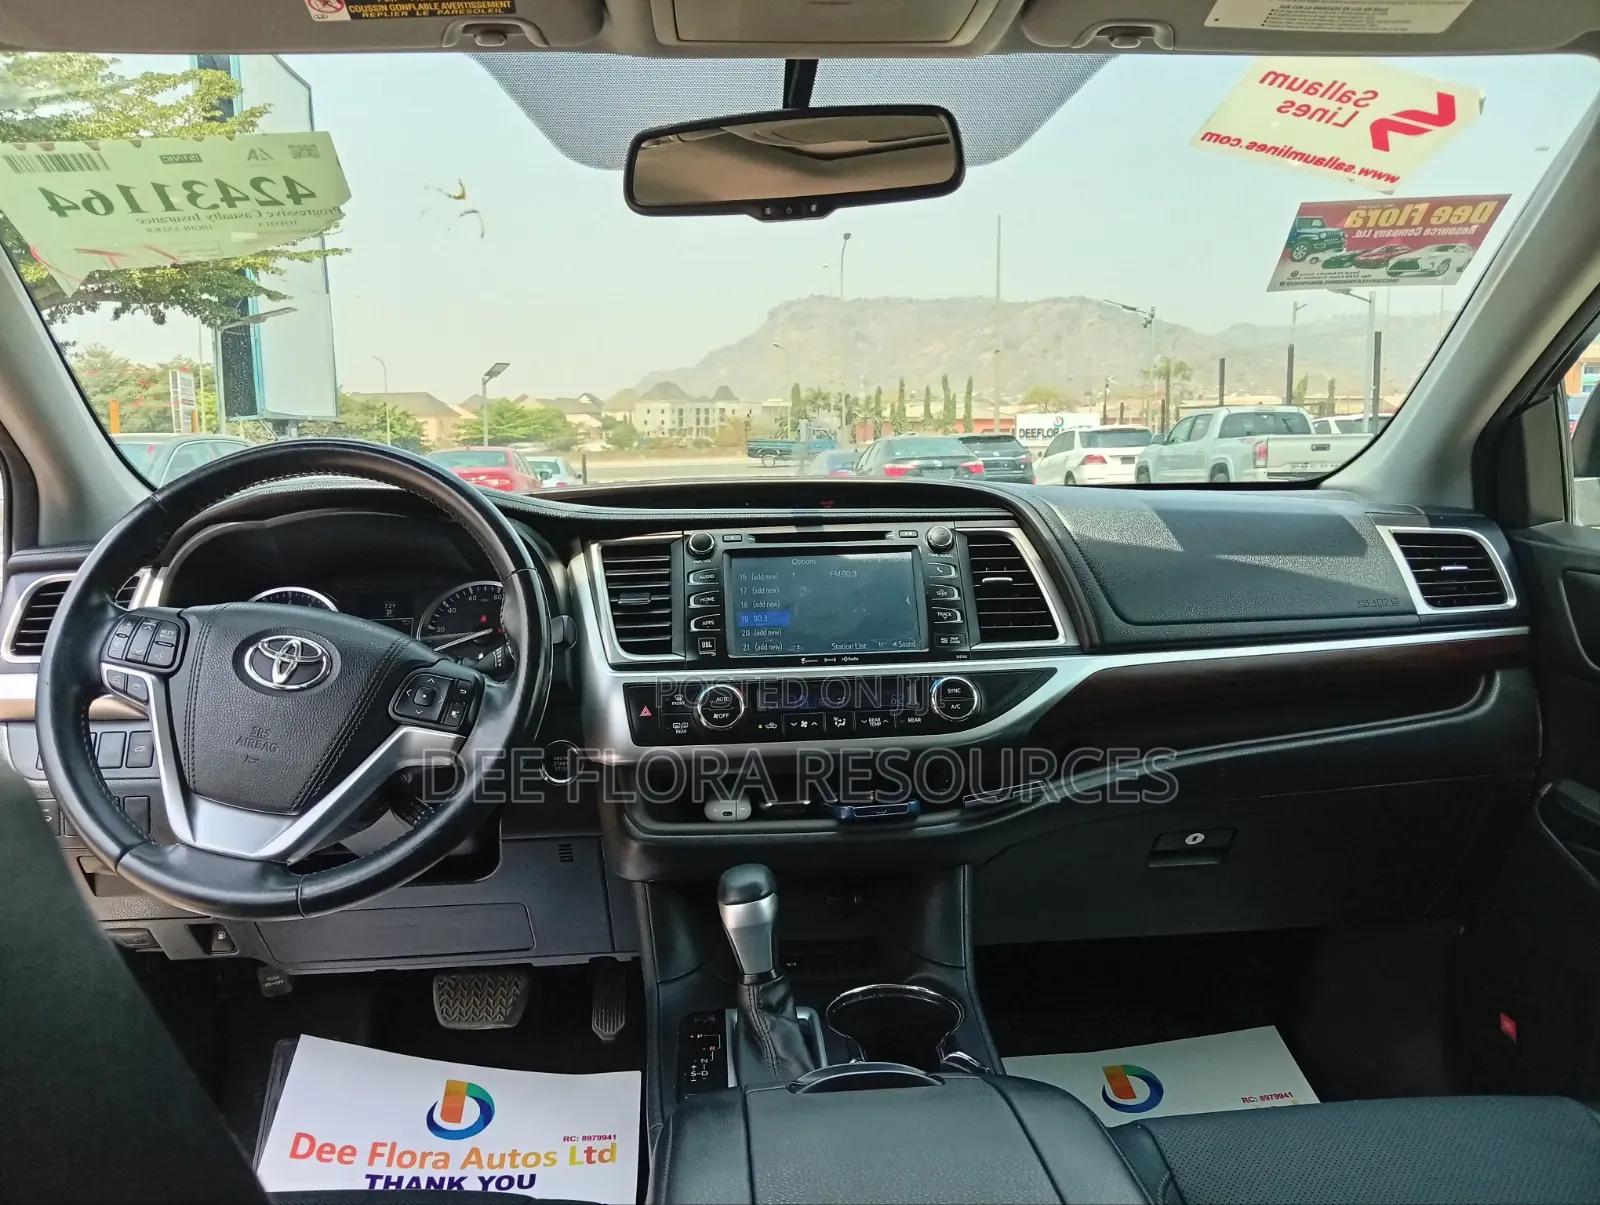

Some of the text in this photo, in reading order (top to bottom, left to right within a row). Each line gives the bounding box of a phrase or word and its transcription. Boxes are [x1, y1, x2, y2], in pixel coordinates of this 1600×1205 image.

[349, 1, 511, 13] COUSSIN GONFLABLE AVERTISSEMENT
[362, 10, 408, 18] REPLIER
[437, 8, 504, 16] PARESOLEIL
[1019, 427, 1065, 438] DEEFLOR
[792, 558, 816, 566] Options
[742, 629, 750, 637] 20
[831, 642, 853, 650] Station
[899, 640, 916, 648] Sound
[251, 726, 270, 737] SRS
[236, 736, 278, 752] AIRBAG
[1241, 1091, 1294, 1105] RC: 8979941
[563, 1134, 617, 1143] RC: 8979941
[289, 1131, 617, 1170] Dee Flora Autos Ltd
[364, 1173, 537, 1191] THANK YOU
